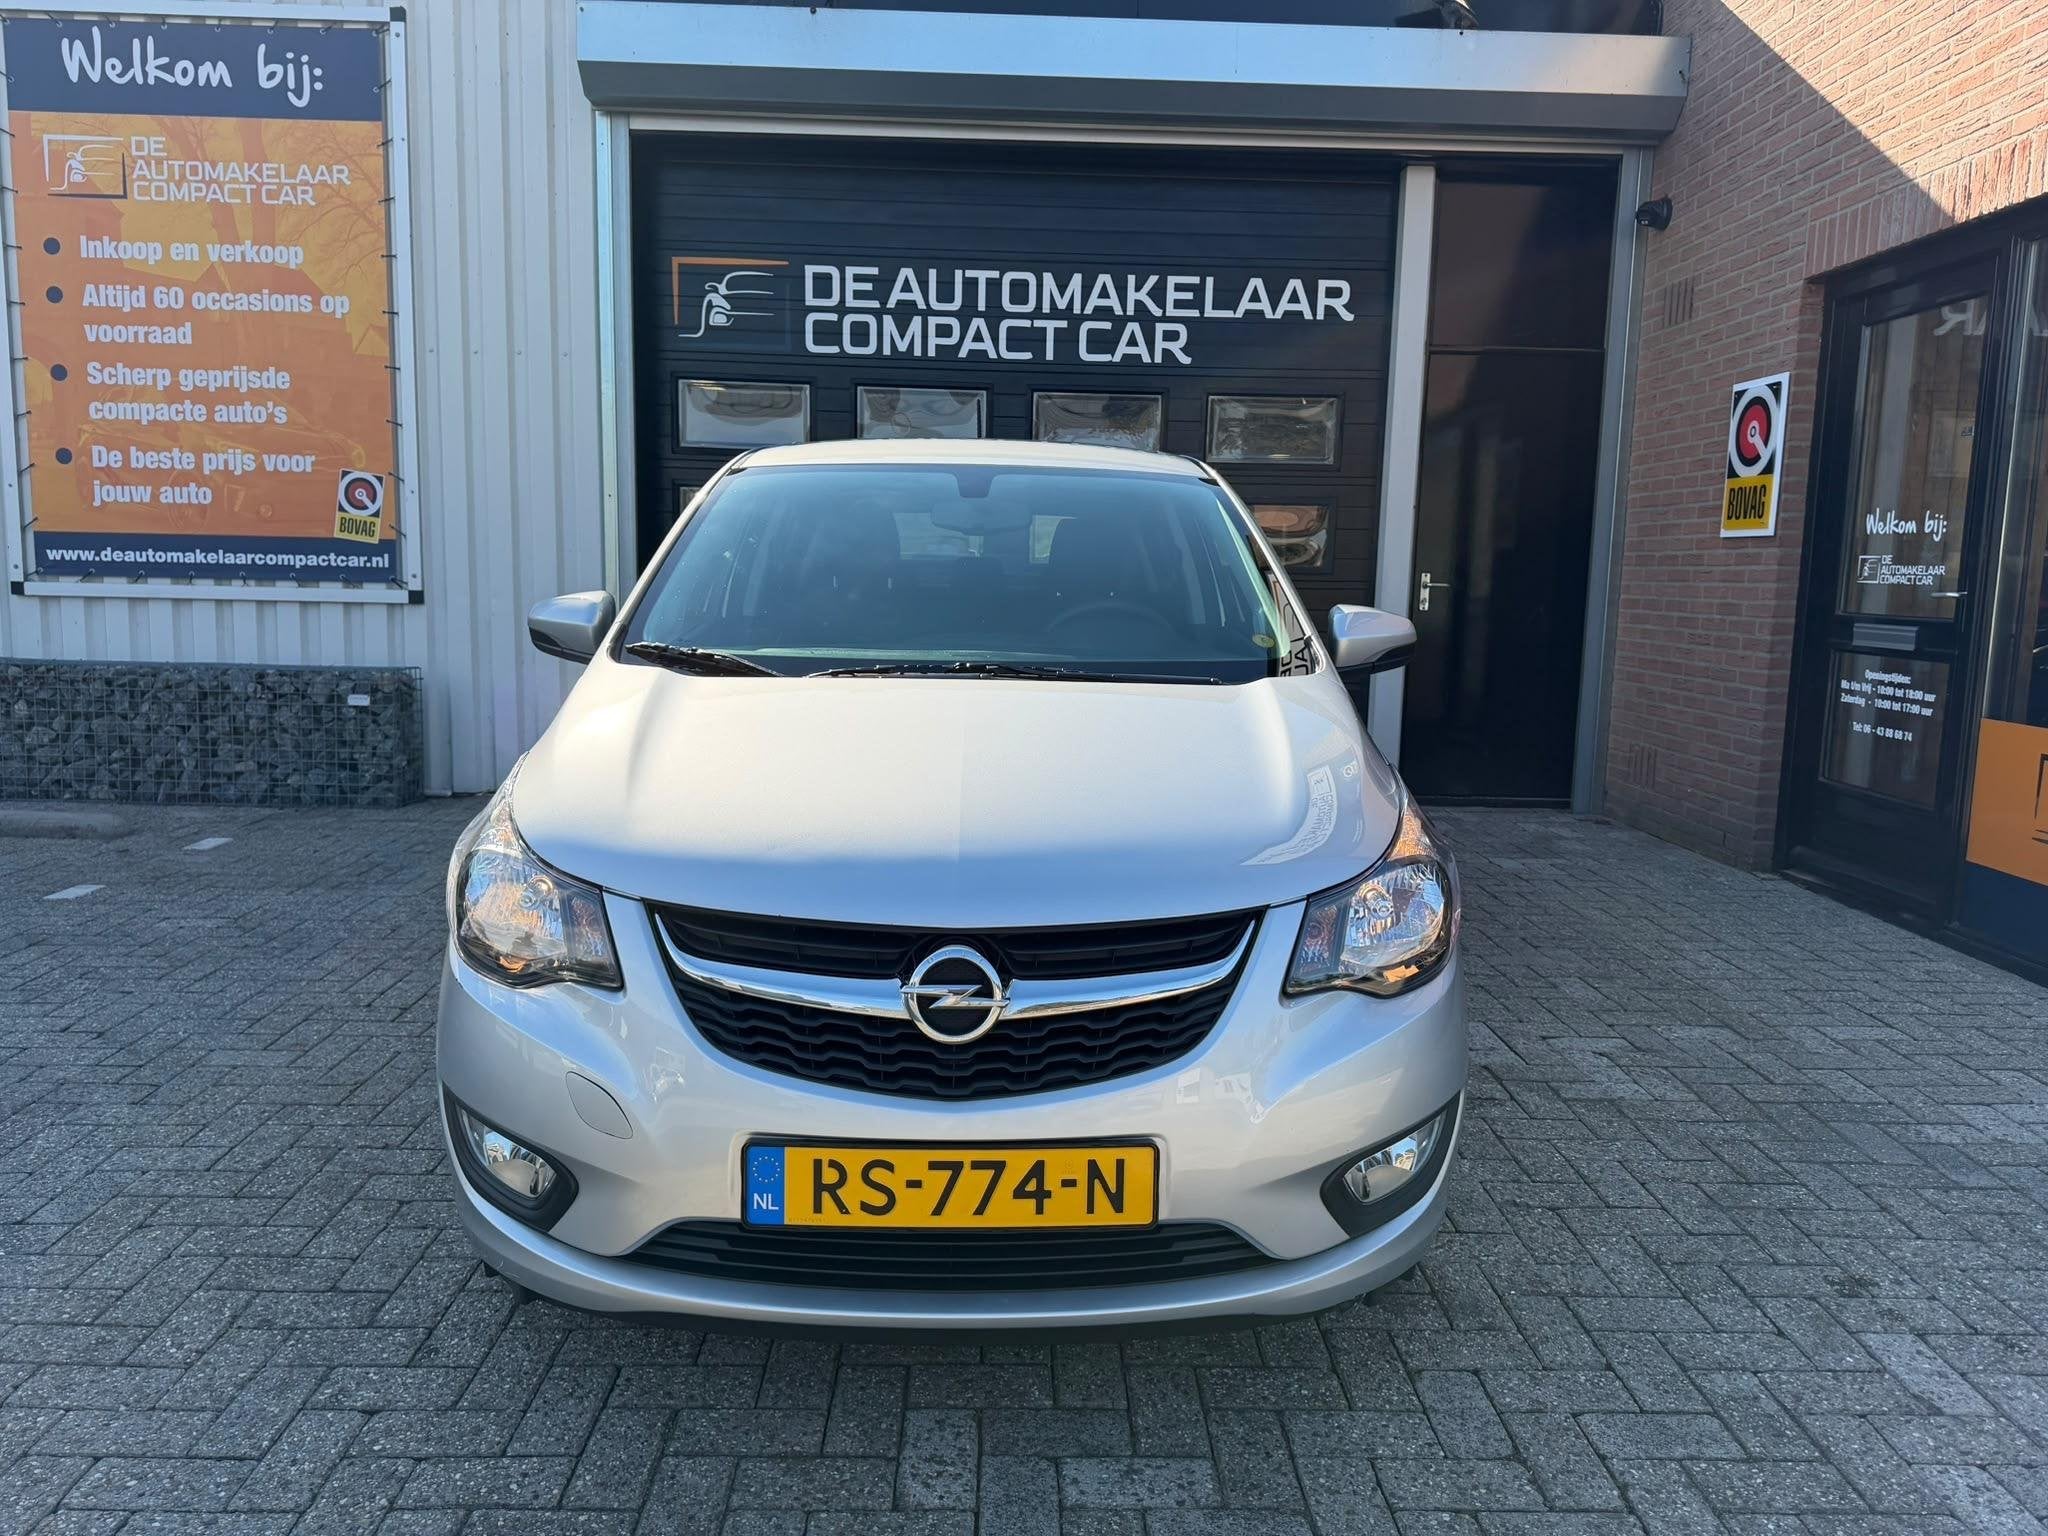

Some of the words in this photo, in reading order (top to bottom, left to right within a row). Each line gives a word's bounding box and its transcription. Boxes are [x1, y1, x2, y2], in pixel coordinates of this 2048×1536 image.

[61, 25, 233, 88] Welkom
[257, 43, 324, 108] bij:
[130, 136, 167, 157] DE
[132, 160, 351, 185] AUTOMAKELAAR
[132, 181, 256, 204] COMPACT
[261, 184, 316, 206] CAR
[80, 235, 162, 265] Inkoop
[170, 241, 200, 260] en
[207, 240, 304, 269] verkoop
[82, 283, 146, 311] Altijd
[153, 286, 184, 308] 60
[192, 289, 312, 312] occasions
[320, 296, 350, 318] op
[804, 264, 880, 309] DE
[888, 267, 1354, 322] AUTOMAKELAAR
[84, 322, 192, 345] voorraad
[804, 311, 1068, 361] COMPACT
[1078, 321, 1193, 365] CAR
[87, 362, 171, 391] Scherp
[179, 365, 291, 392] geprijsde
[89, 400, 207, 425] compacte
[214, 400, 288, 424] auto's
[91, 446, 122, 468] De
[131, 447, 195, 470] beste
[203, 449, 256, 475] prijs
[263, 452, 315, 472] voor
[93, 481, 152, 506] jouw
[159, 482, 212, 505] auto
[1727, 484, 1766, 520] BOVAG
[339, 516, 376, 538] BOVAG
[1866, 507, 1917, 535] Welkom
[1924, 510, 1947, 542] bij:
[46, 546, 390, 569] www.deautomakelaarcompactcar.nl
[1880, 565, 1946, 575] AUTOMAKELAAR
[1881, 555, 1894, 565] DE
[1879, 574, 1916, 585] COMPACT
[1916, 576, 1934, 586] CAR
[812, 1157, 1125, 1217] RS-774-N
[753, 1193, 779, 1210] NL
